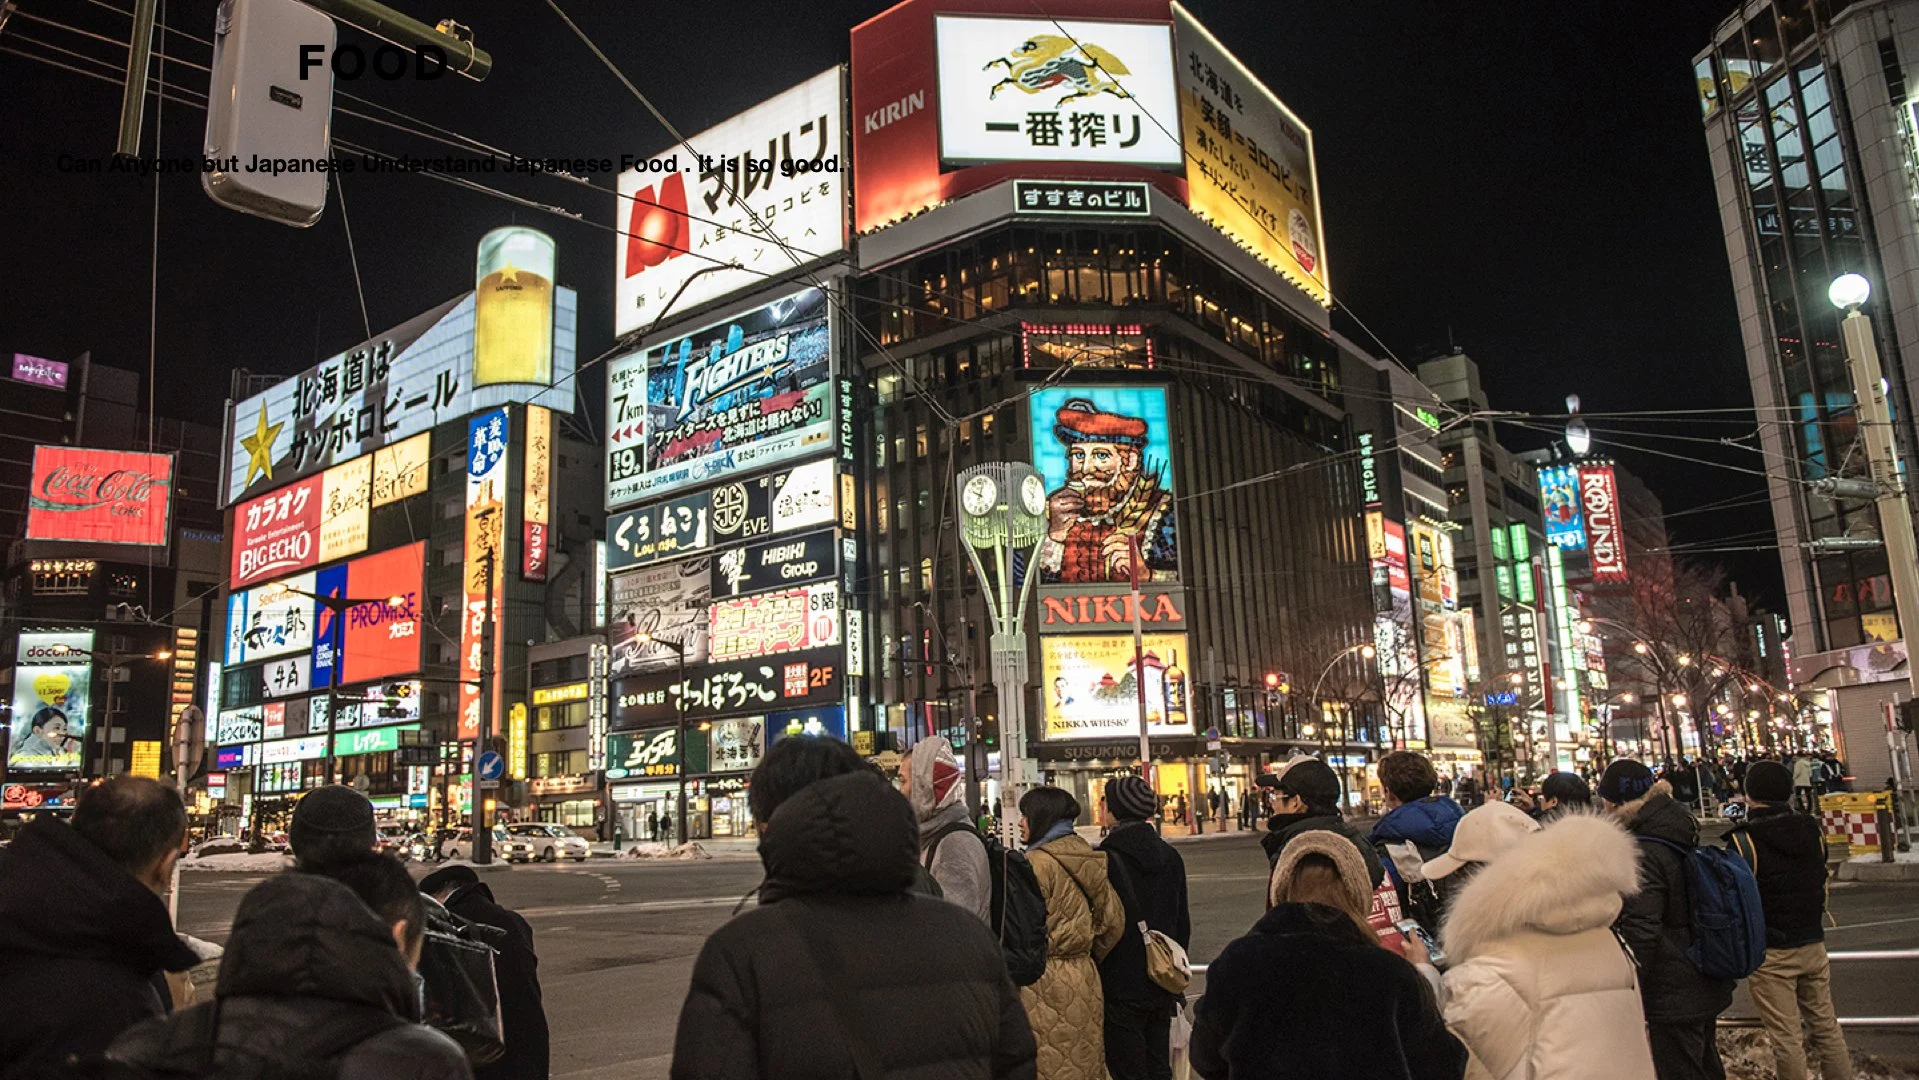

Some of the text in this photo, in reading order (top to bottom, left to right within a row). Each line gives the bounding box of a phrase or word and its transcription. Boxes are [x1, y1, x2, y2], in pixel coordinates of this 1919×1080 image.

[864, 90, 925, 134] KIRIN
[984, 111, 1141, 148] 一番搾り
[699, 114, 828, 216] マルハン
[1024, 188, 1141, 208] すすきのビル
[291, 340, 395, 420] 北海道は
[675, 332, 790, 422] FIGHTERS
[289, 367, 459, 472] サッポロビール
[654, 400, 762, 446] ファイターズを見ずに
[245, 486, 312, 533] カラオケ
[615, 505, 693, 551] くろねこ
[743, 516, 770, 538] EVE
[1583, 472, 1623, 574] ROUND1
[530, 524, 542, 571] カラオケ
[761, 541, 806, 566] HIBIKI
[781, 560, 818, 579] Group
[1042, 593, 1183, 625] NIKKA
[274, 660, 299, 690] 牛角
[668, 664, 777, 713] さっぽろっこ
[810, 666, 834, 688] 2F
[1053, 717, 1130, 730] NIKKA WHISKY
[1063, 745, 1138, 759] SUSUKINO
